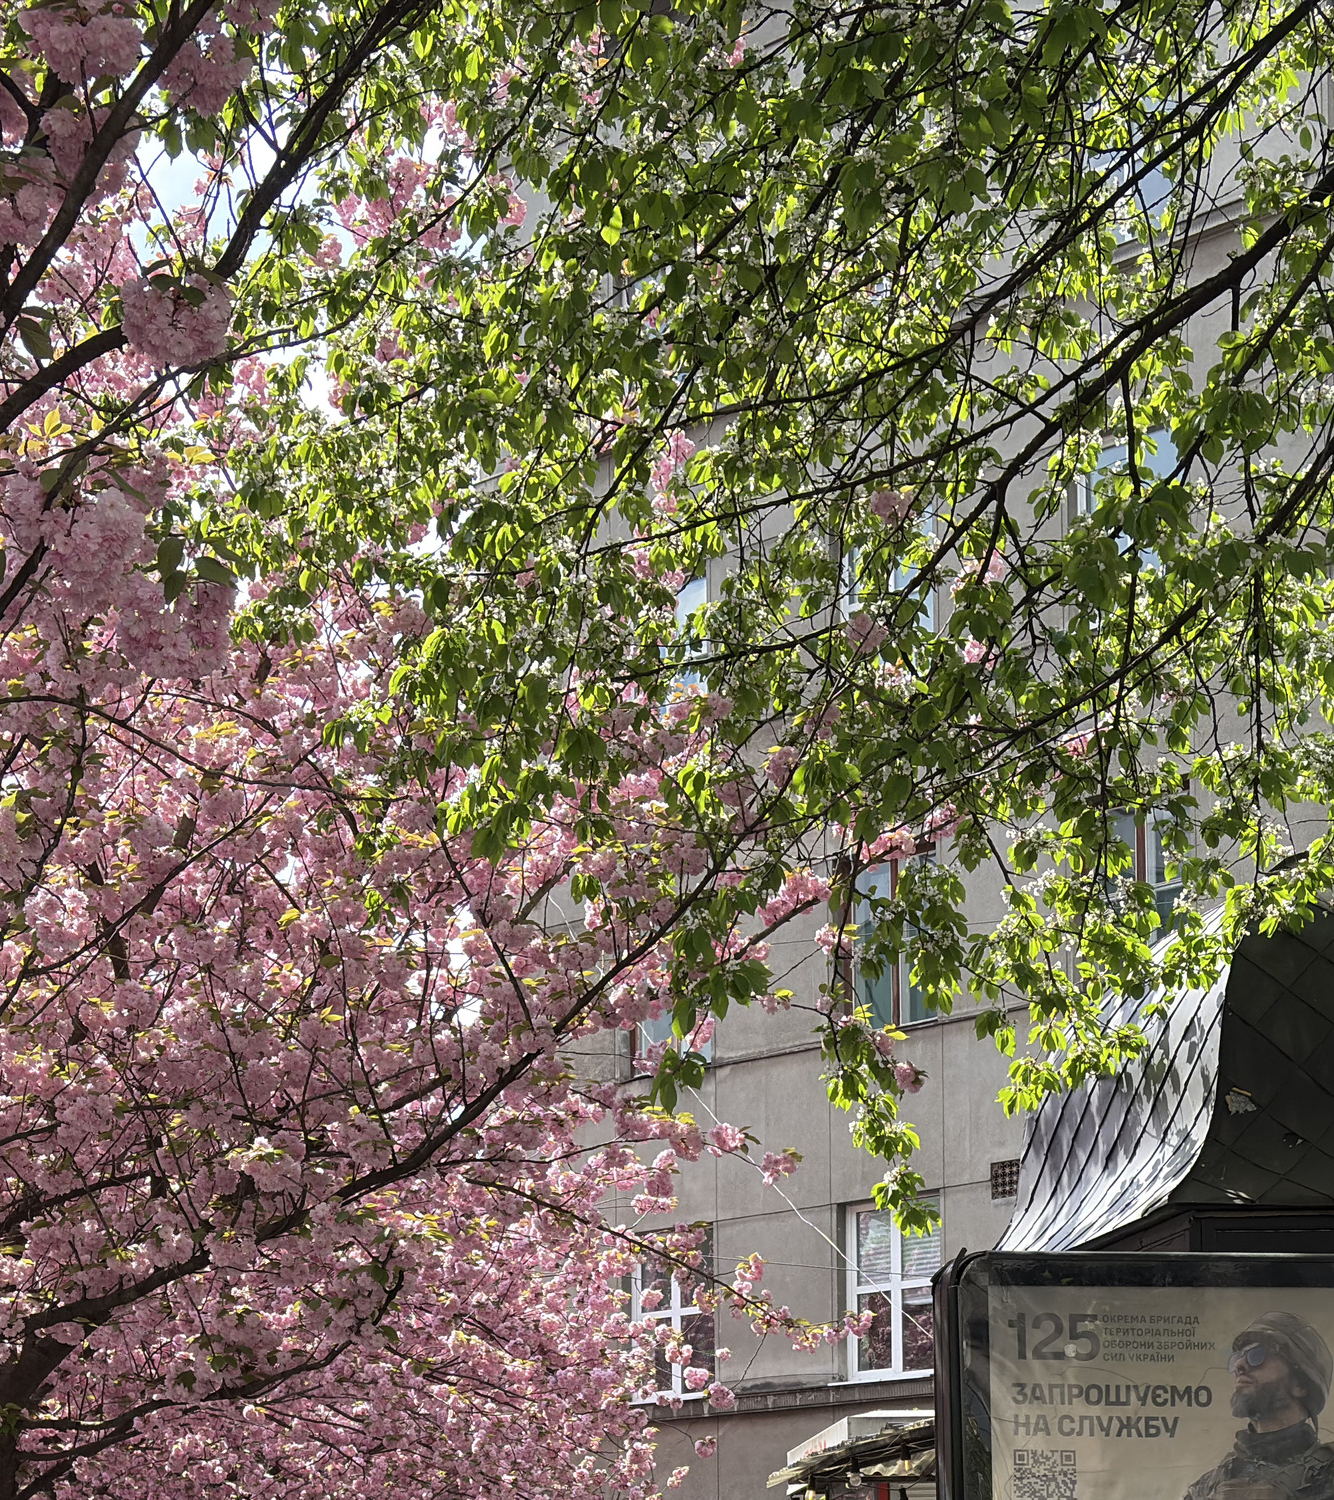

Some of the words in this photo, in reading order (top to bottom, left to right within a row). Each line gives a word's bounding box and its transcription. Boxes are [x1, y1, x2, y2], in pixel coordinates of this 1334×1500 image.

[1102, 1314, 1146, 1324] ОКРЕМА
[1149, 1315, 1200, 1325] БРИГАДА
[1008, 1312, 1101, 1361] 125
[1103, 1326, 1196, 1337] ТЕРИТОРІАЛЬНОЇ
[1102, 1339, 1154, 1350] ОБОРОНИ
[1156, 1339, 1216, 1350] ЗБРОЙНИХ
[1103, 1353, 1126, 1362] СИЛ
[1129, 1352, 1175, 1363] УКРАЇНИ
[1011, 1382, 1213, 1408] ЗАПРОШУЄМО
[1013, 1414, 1051, 1437] НА
[1057, 1414, 1180, 1438] СЛУЖБУ
